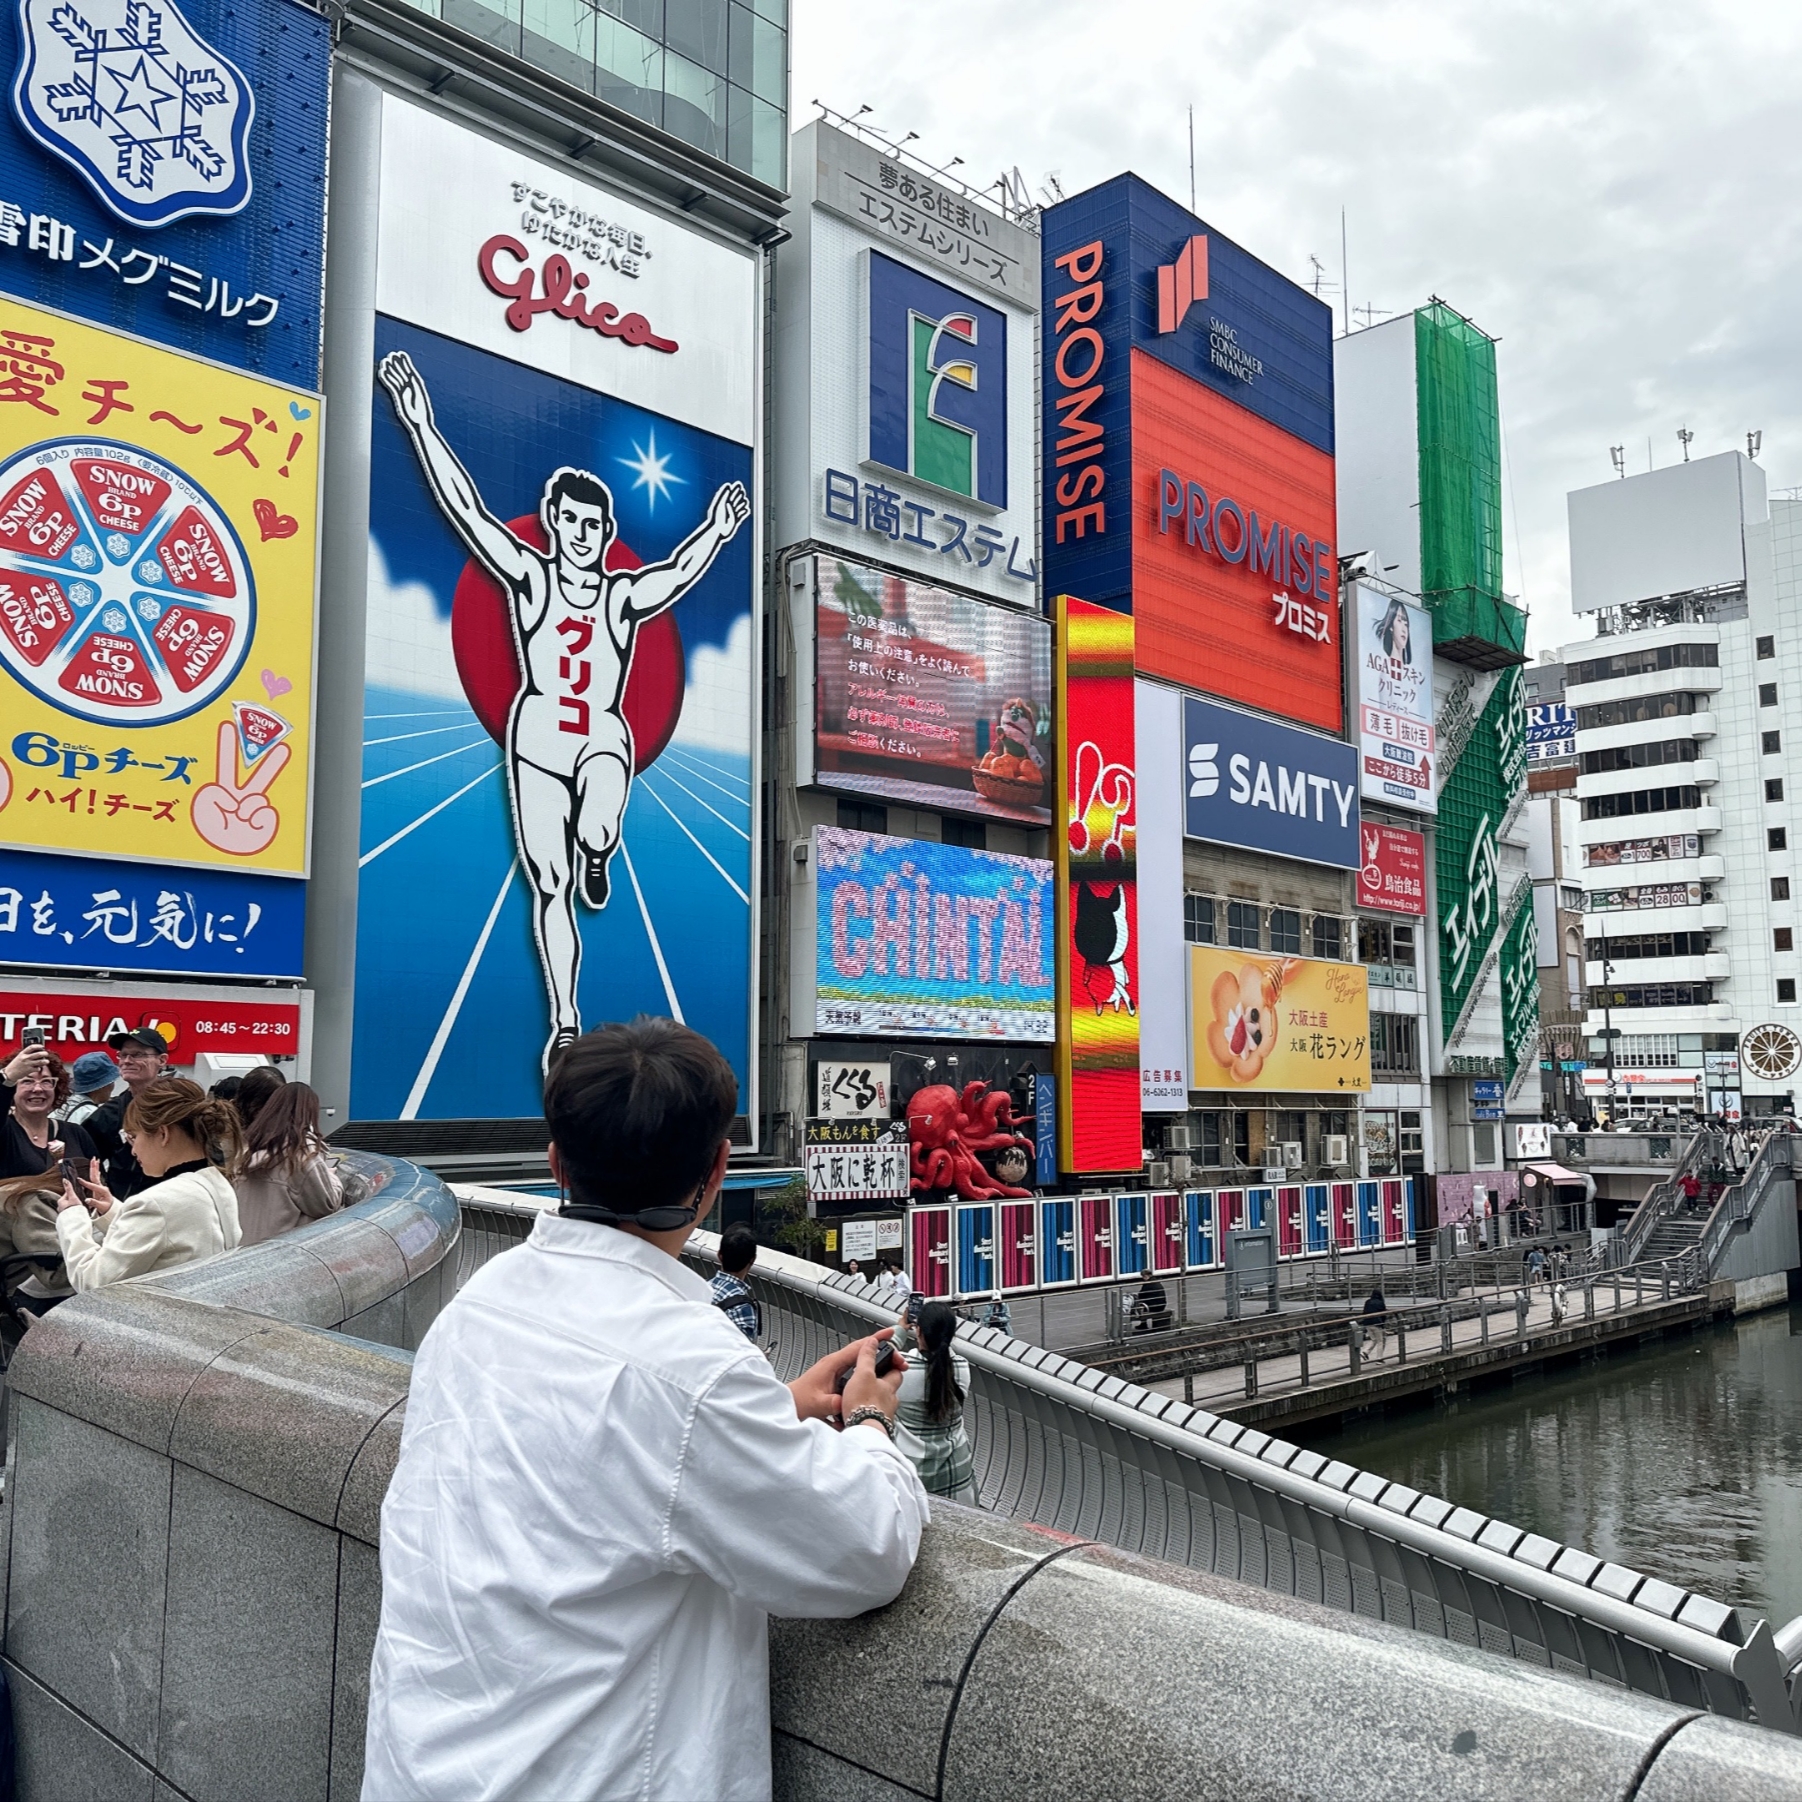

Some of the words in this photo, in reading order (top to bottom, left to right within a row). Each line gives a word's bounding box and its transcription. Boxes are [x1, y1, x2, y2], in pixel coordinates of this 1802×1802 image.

[879, 161, 989, 236] 夢ある住まい
[522, 210, 640, 279] ゆたかな人生
[859, 191, 1007, 286] エステムシリーズ
[478, 234, 679, 354] Glico
[1210, 316, 1238, 344] SMBC
[1210, 333, 1264, 377] CONSUMER
[1211, 348, 1254, 386] FINANCE
[1054, 240, 1105, 544] PROMISE
[36, 449, 70, 465] 6個入り
[74, 447, 131, 464] 内容量102g
[89, 465, 157, 496] SNOW
[107, 486, 137, 499] BRAND
[0, 478, 48, 537] SNOW
[24, 505, 45, 530] BRAND
[99, 514, 139, 532] CHEESE
[826, 467, 1038, 582] 日商エステム
[48, 523, 77, 556] CHEESE
[1159, 468, 1331, 602] PROMISE
[160, 546, 184, 584] CHEESE
[189, 523, 230, 584] SNOW
[190, 544, 207, 571] BRAND
[0, 584, 39, 647] SNOW
[19, 596, 38, 626] BRAND
[45, 582, 71, 621] CHEESE
[1272, 591, 1333, 645] プロミス
[156, 608, 182, 641] CHEESE
[93, 636, 133, 652] CHEESE
[183, 626, 225, 682] SNOW
[185, 635, 202, 656] BRAND
[96, 668, 125, 680] BRAND
[555, 615, 596, 736] グリコ
[848, 659, 920, 688] お使いください。
[1366, 652, 1390, 675] AGA
[1403, 667, 1426, 686] スキン
[75, 673, 143, 700] SNOW
[1378, 677, 1416, 703] クリニック
[247, 712, 277, 730] SNOW
[1370, 713, 1393, 736] 薄毛
[1401, 722, 1428, 746] 抜け毛
[1229, 752, 1355, 828] SAMTY
[1368, 759, 1427, 787] ここから徒歩5分
[1443, 812, 1500, 994] エイブル
[832, 876, 1050, 987] CHINTAI
[1504, 910, 1540, 1020] エイブル
[1289, 1009, 1328, 1028] 大阪土産
[1028, 1074, 1035, 1106] 2F
[1142, 1069, 1182, 1083] 広告募集
[812, 1153, 895, 1190] 大阪に乾杯
